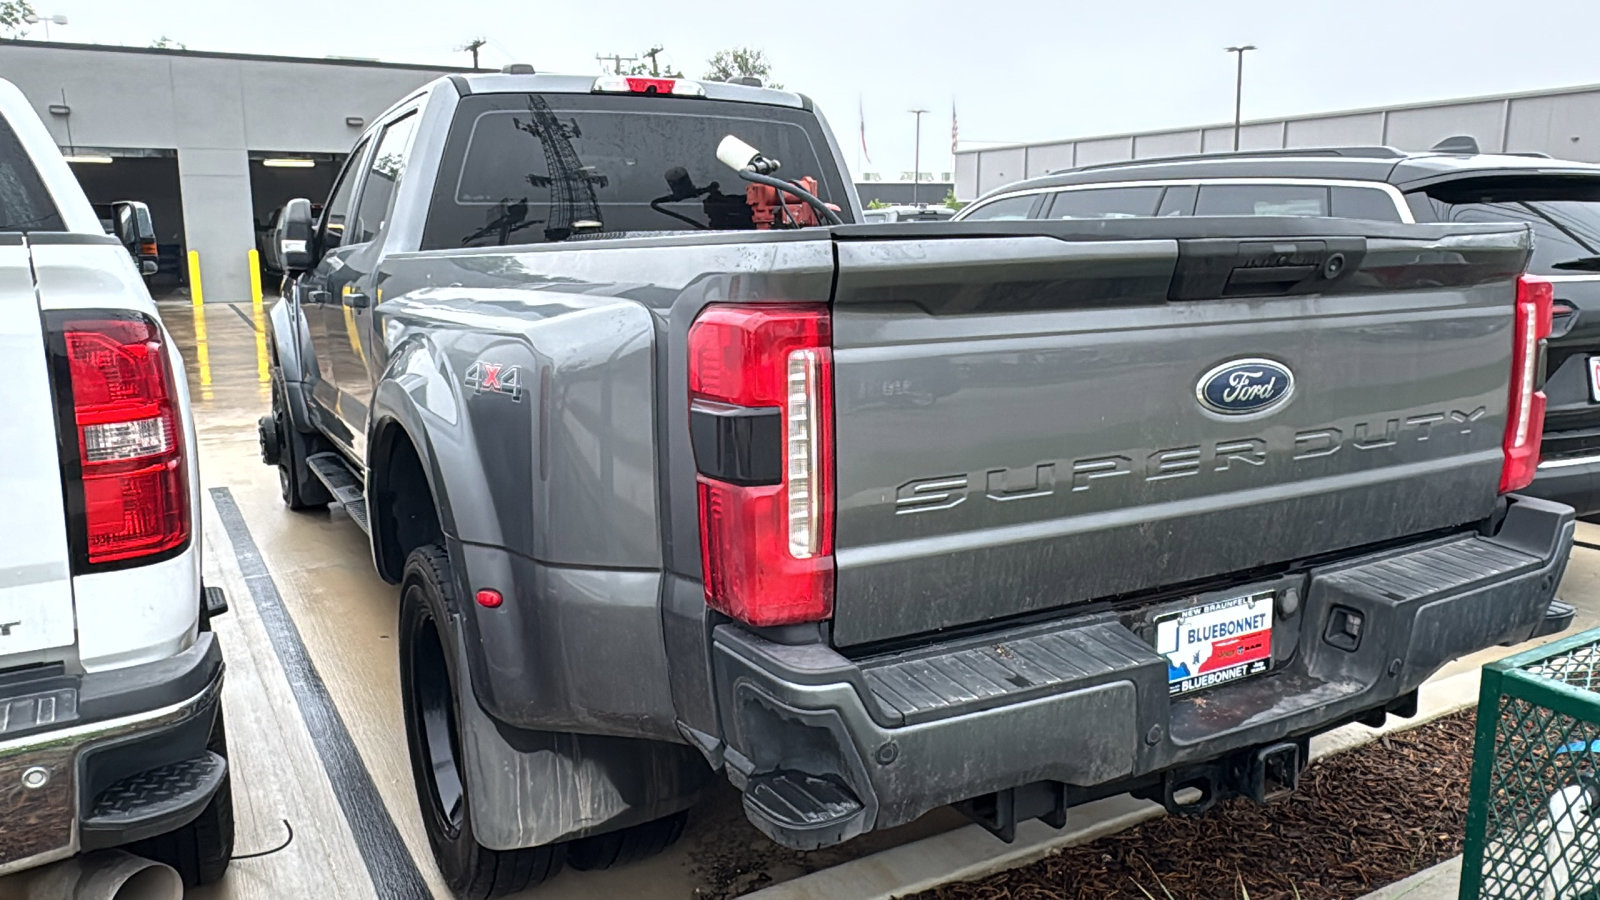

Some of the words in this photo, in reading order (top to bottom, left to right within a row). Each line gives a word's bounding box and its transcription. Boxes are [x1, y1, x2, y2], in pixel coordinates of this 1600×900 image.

[1223, 371, 1277, 403] Ford
[896, 436, 1267, 515] SUPER
[1293, 405, 1486, 460] DUTY
[1182, 608, 1202, 618] NEW
[1203, 597, 1253, 612] BRAUNFEL
[1188, 613, 1266, 644] BLUEBONNET
[1181, 664, 1249, 692] BLUEBONNET
